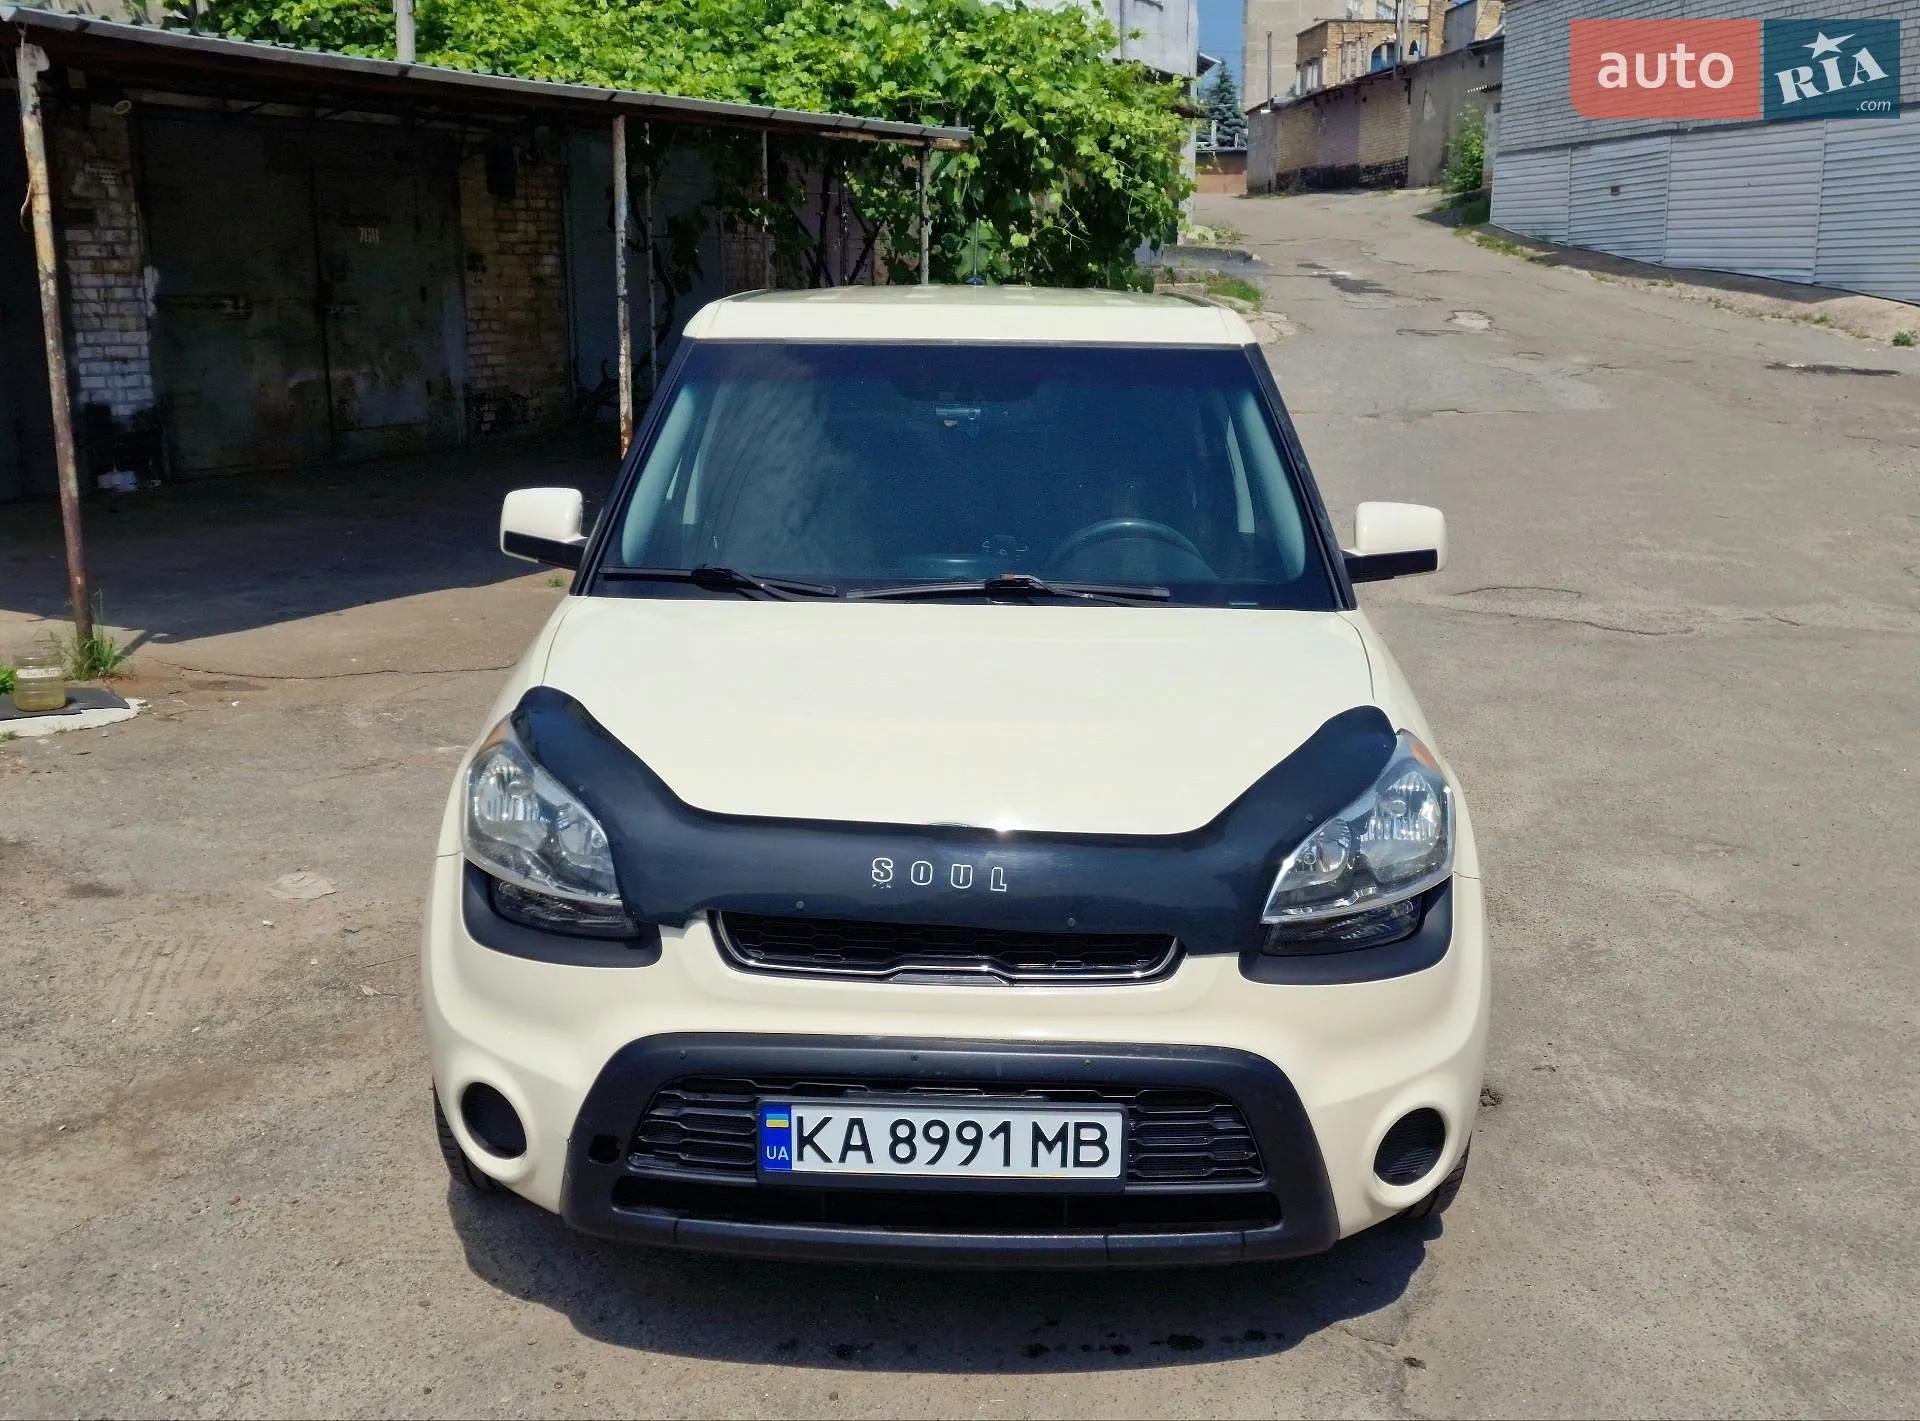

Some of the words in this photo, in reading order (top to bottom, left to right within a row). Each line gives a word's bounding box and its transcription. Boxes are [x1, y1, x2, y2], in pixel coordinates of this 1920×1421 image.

[871, 857, 1007, 892] SOUL
[766, 1145, 789, 1161] UA
[796, 1115, 874, 1164] KA
[888, 1119, 1011, 1167] 8991
[1030, 1121, 1110, 1168] MB
